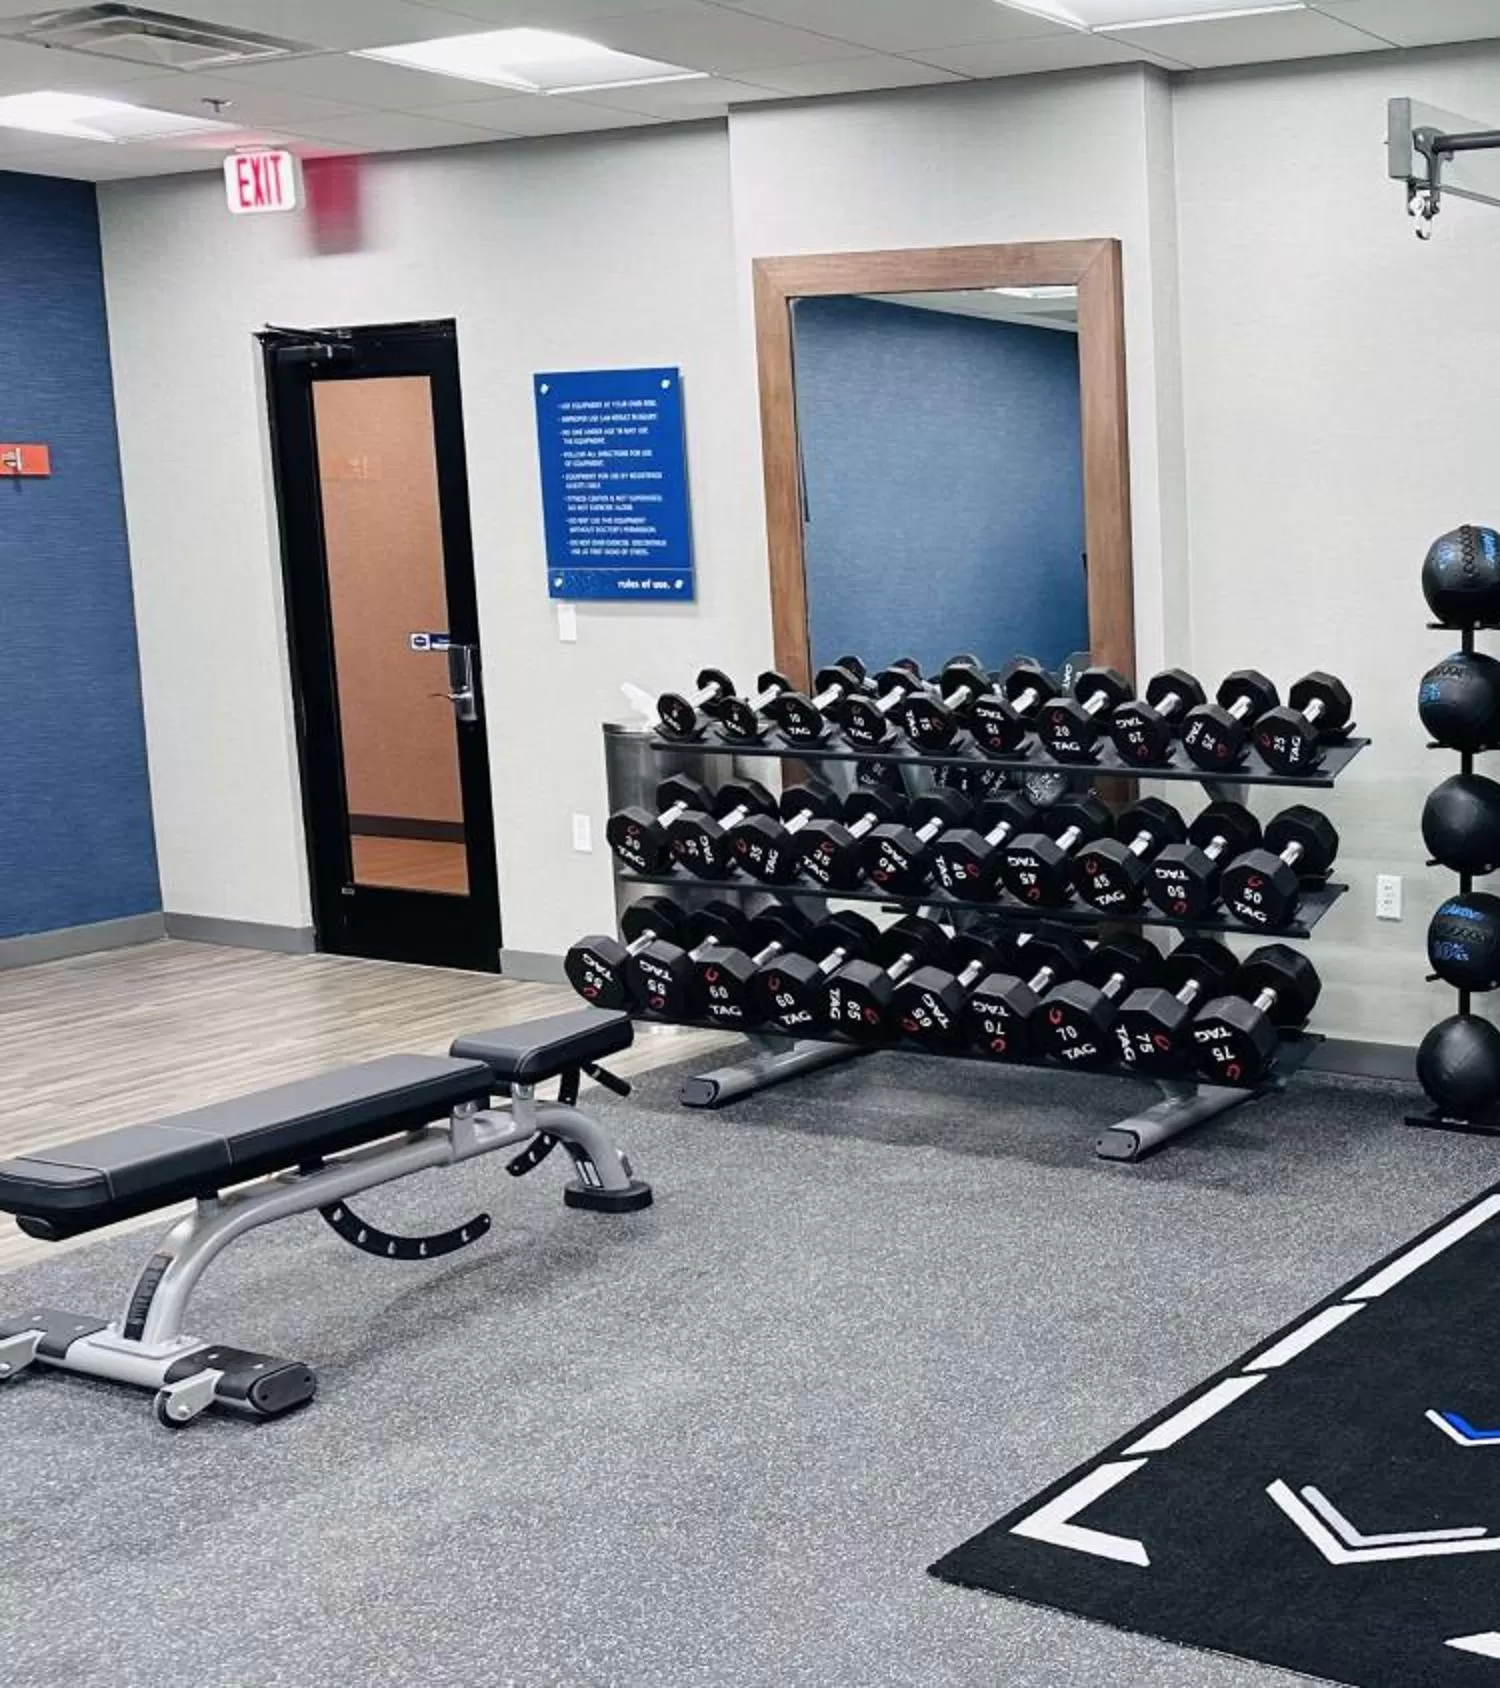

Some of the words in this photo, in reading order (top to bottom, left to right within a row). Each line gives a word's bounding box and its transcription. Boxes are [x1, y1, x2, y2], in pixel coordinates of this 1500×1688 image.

[236, 155, 282, 207] EXIT
[788, 727, 811, 735] TAG
[906, 710, 919, 737] TAG
[1116, 717, 1144, 729] TAG
[849, 728, 873, 740] TAG
[1186, 721, 1204, 745] TAG
[1053, 741, 1080, 751] TAG
[1289, 736, 1301, 762] TAG
[618, 845, 645, 867] TAG
[765, 849, 778, 873] TAG
[881, 841, 908, 869] TAG
[1008, 856, 1039, 867] TAG
[803, 855, 829, 882] TAG
[880, 858, 896, 872] 40
[936, 856, 952, 887] TAG
[953, 862, 968, 879] 40
[1156, 868, 1190, 880] TAG
[1095, 890, 1126, 905] TAG
[1244, 888, 1262, 904] 50
[1233, 901, 1267, 923] TAG
[583, 954, 613, 981] TAG
[640, 960, 672, 982] TAG
[709, 986, 729, 999] 60
[708, 1004, 742, 1016] TAG
[830, 988, 840, 1020] TAG
[848, 1001, 860, 1020] 65
[921, 994, 949, 1029] TAG
[972, 1000, 1009, 1017] TAG
[780, 1010, 812, 1024] TAG
[984, 1020, 1005, 1035] 70
[1056, 1026, 1077, 1040] 70
[1194, 1026, 1232, 1043] TAG
[1116, 1024, 1136, 1061] TAG
[1136, 1034, 1154, 1052] 75
[1062, 1044, 1097, 1060] TAG
[1212, 1045, 1235, 1061] 75
